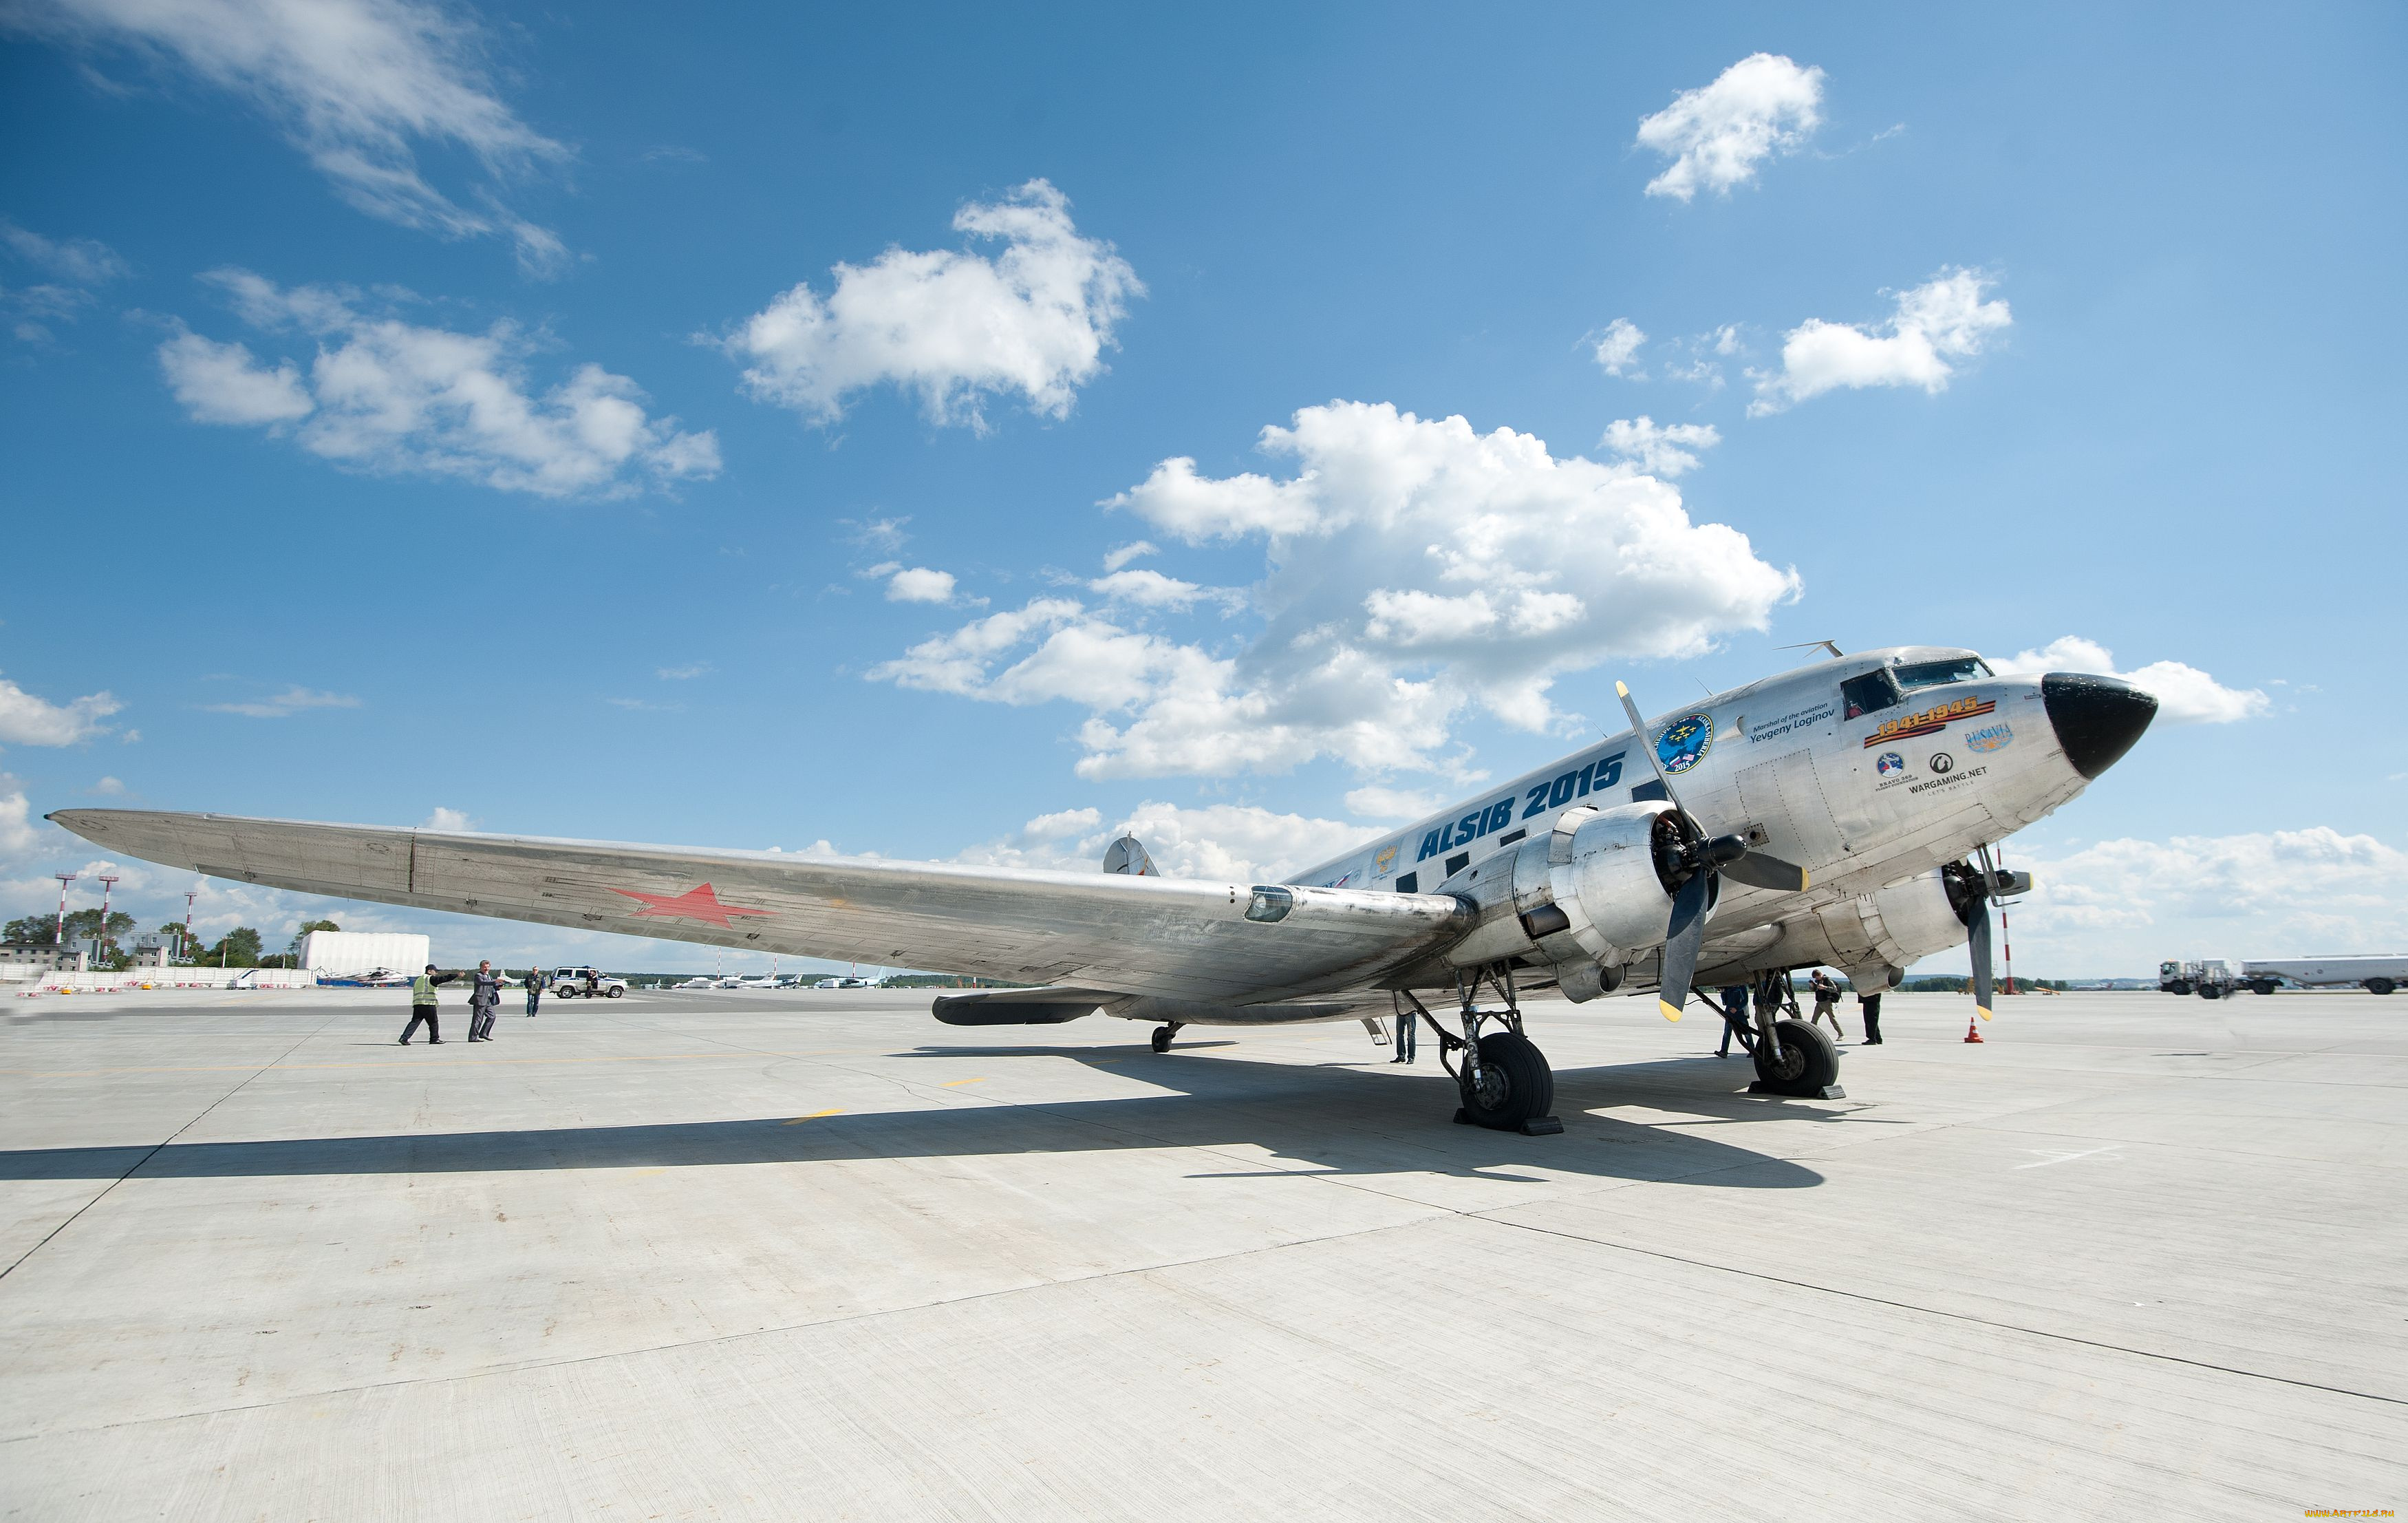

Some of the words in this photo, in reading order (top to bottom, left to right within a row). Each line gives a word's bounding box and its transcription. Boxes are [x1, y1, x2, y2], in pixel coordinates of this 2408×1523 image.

[1750, 724, 1792, 743] Yevgeny
[1794, 709, 1835, 729] Loginov
[1753, 718, 1779, 732] Marshal
[1800, 703, 1828, 716] aviation
[1878, 695, 1978, 738] 1941-1945
[1675, 760, 1690, 771] 2015
[1880, 778, 1900, 787] BRAVO
[1909, 766, 1987, 794] WARGAMING.NET
[1949, 780, 1974, 791] BATTLE
[1417, 796, 1516, 863] ALSIB
[1522, 750, 1626, 820] 2015
